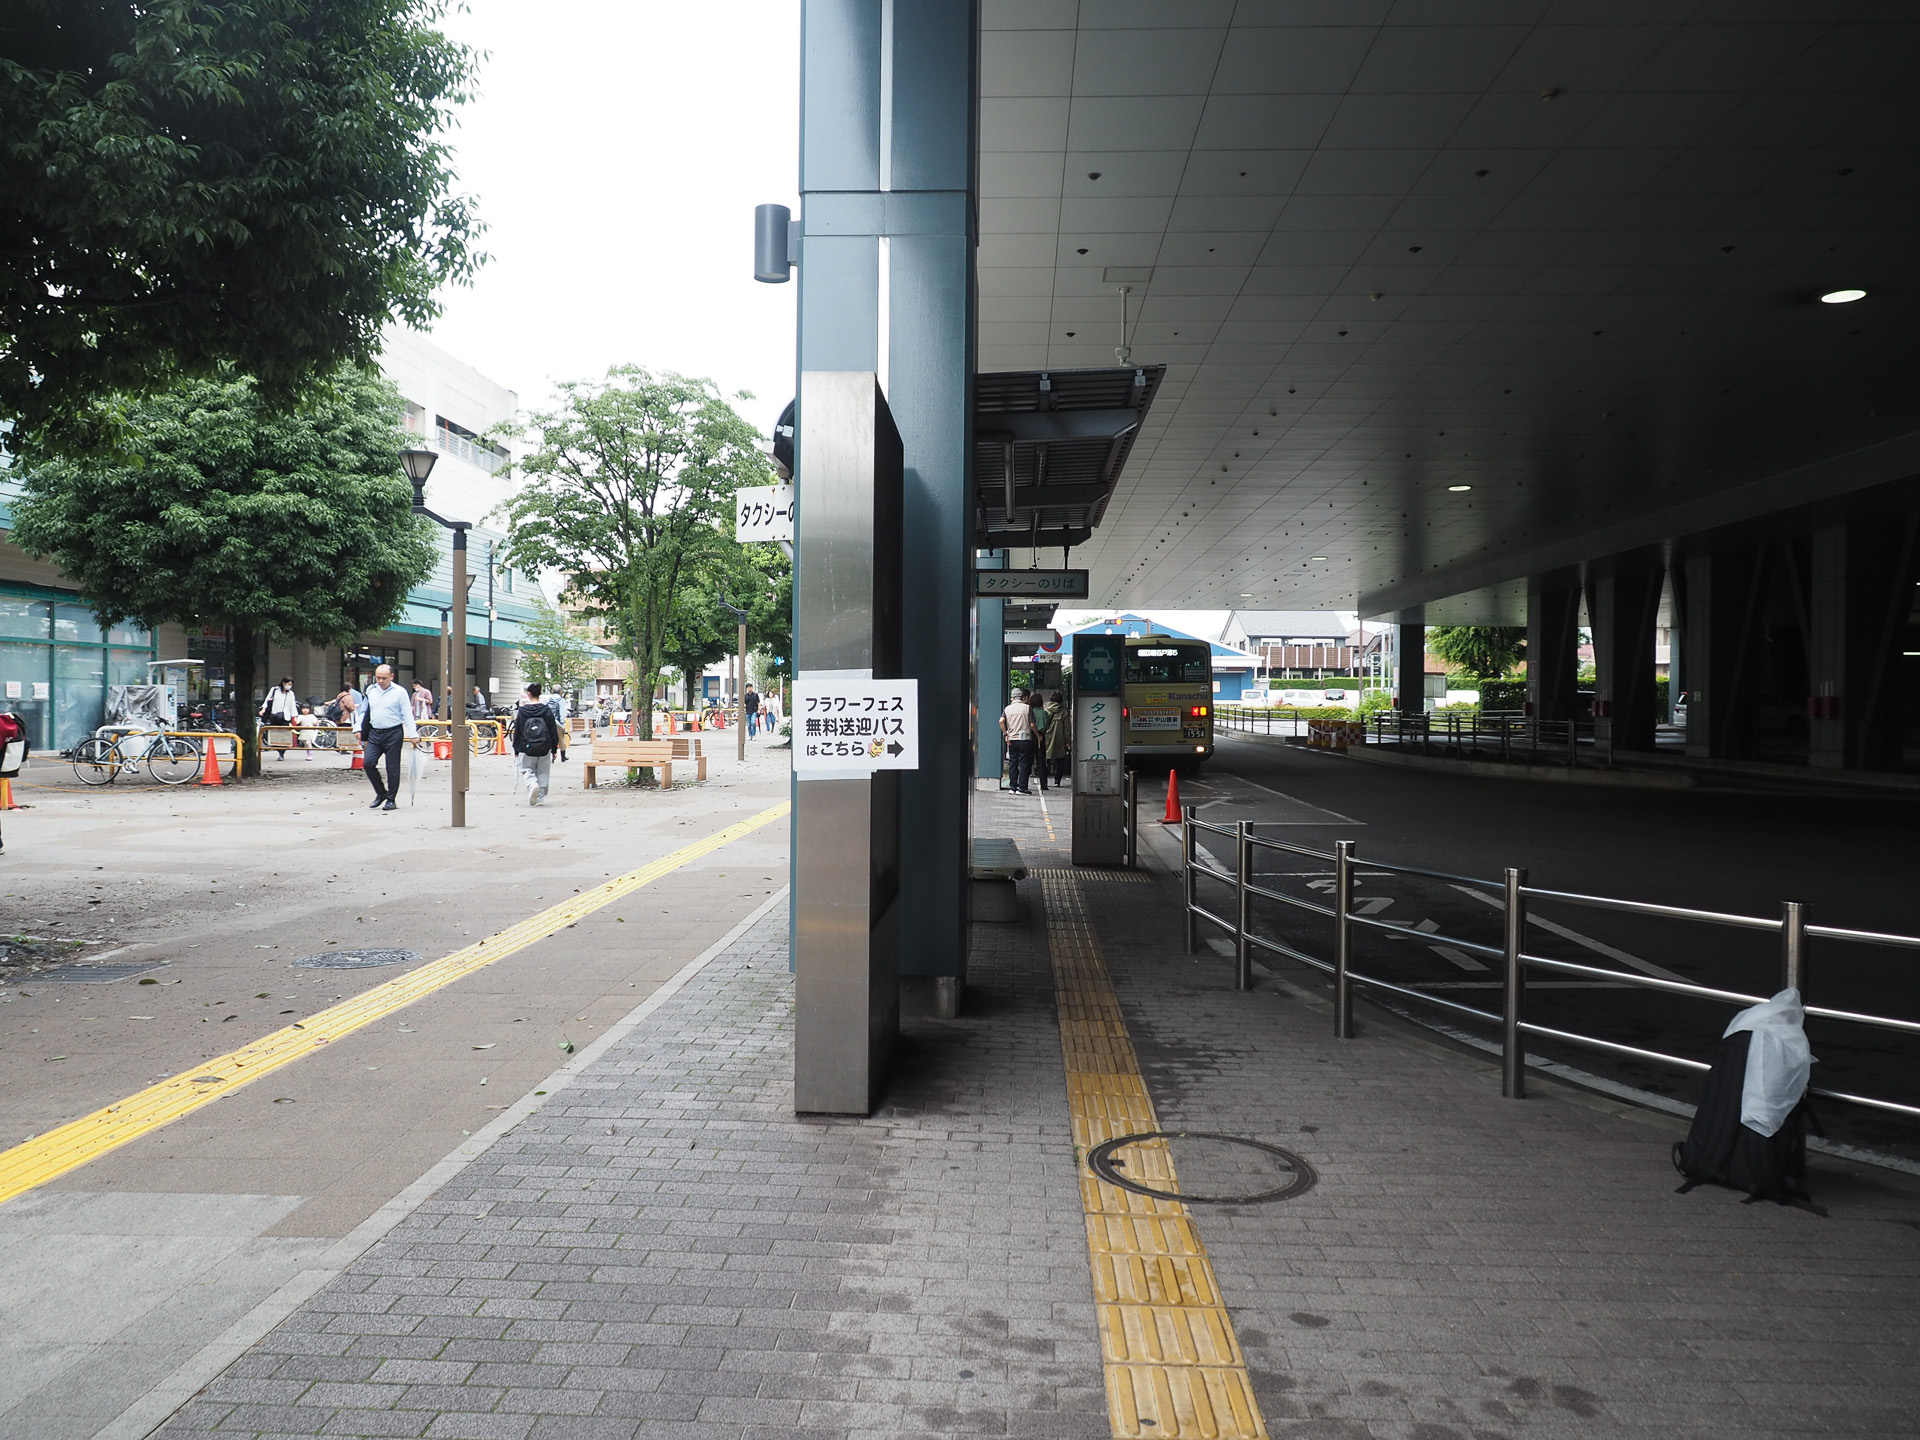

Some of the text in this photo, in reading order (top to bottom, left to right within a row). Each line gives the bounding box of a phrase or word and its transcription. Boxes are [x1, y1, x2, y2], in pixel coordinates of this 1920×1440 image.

[986, 578, 1076, 589] タクシーのりば
[1168, 692, 1208, 700] Kanachu
[805, 697, 904, 712] フラワーフェス
[805, 716, 905, 737] 無料送迎バス
[806, 741, 865, 756] はこちら
